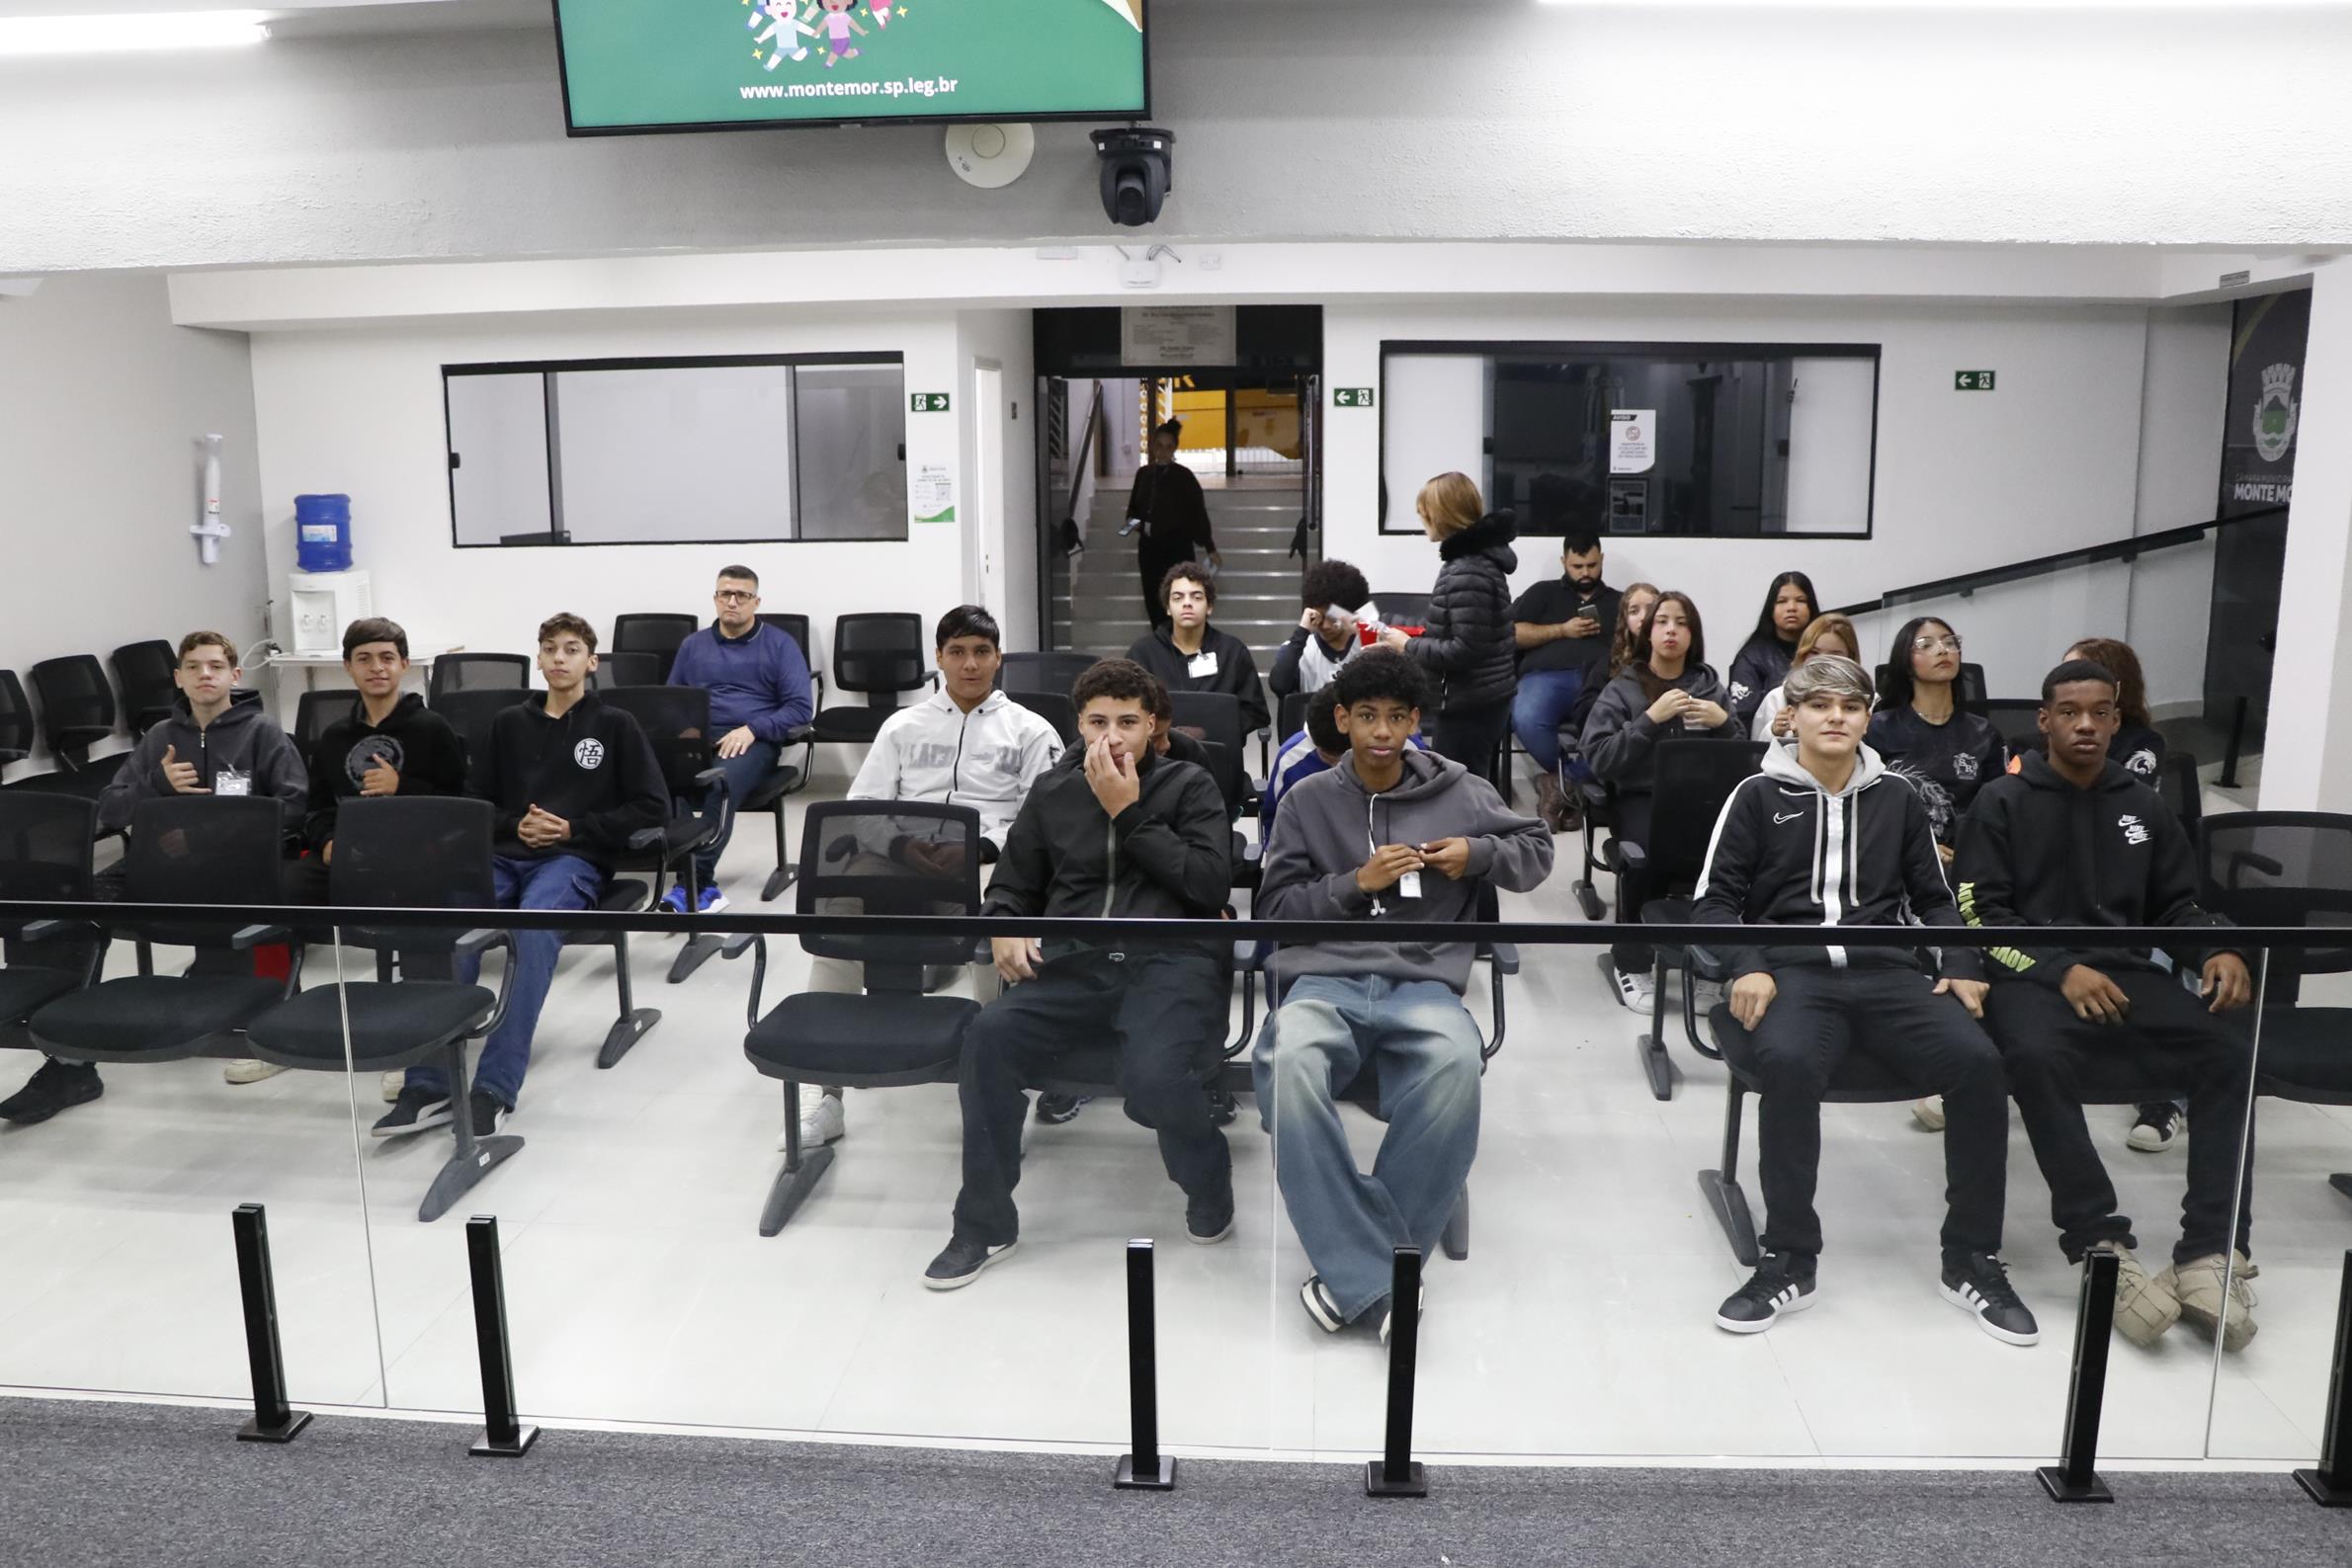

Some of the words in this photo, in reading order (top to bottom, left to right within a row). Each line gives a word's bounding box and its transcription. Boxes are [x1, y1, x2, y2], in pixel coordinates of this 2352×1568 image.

[740, 77, 958, 99] www.montemor.sp.leg.br
[2233, 483, 2275, 502] MONTE
[2276, 485, 2293, 503] MO
